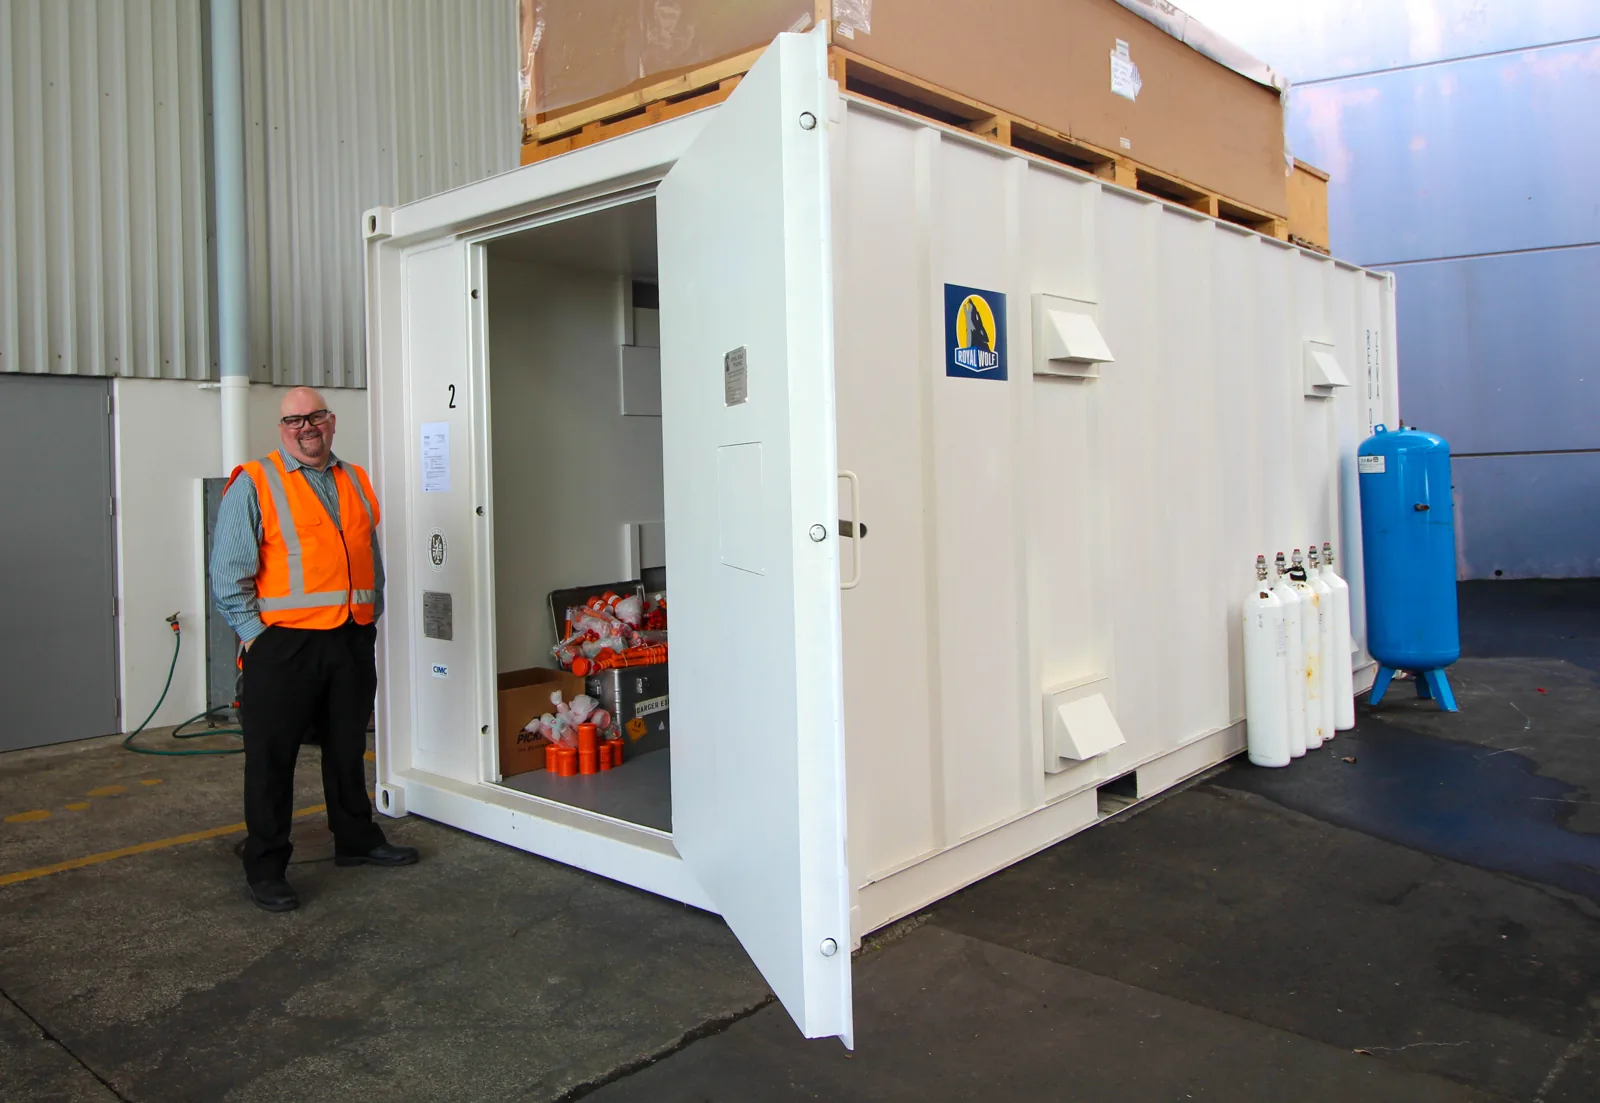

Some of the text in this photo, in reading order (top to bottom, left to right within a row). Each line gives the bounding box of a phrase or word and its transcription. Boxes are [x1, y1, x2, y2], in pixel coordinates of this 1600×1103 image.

[957, 349, 996, 367] ROYAL WOLF
[448, 383, 456, 409] 2
[432, 665, 448, 675] CIMC
[636, 702, 659, 715] DANGER
